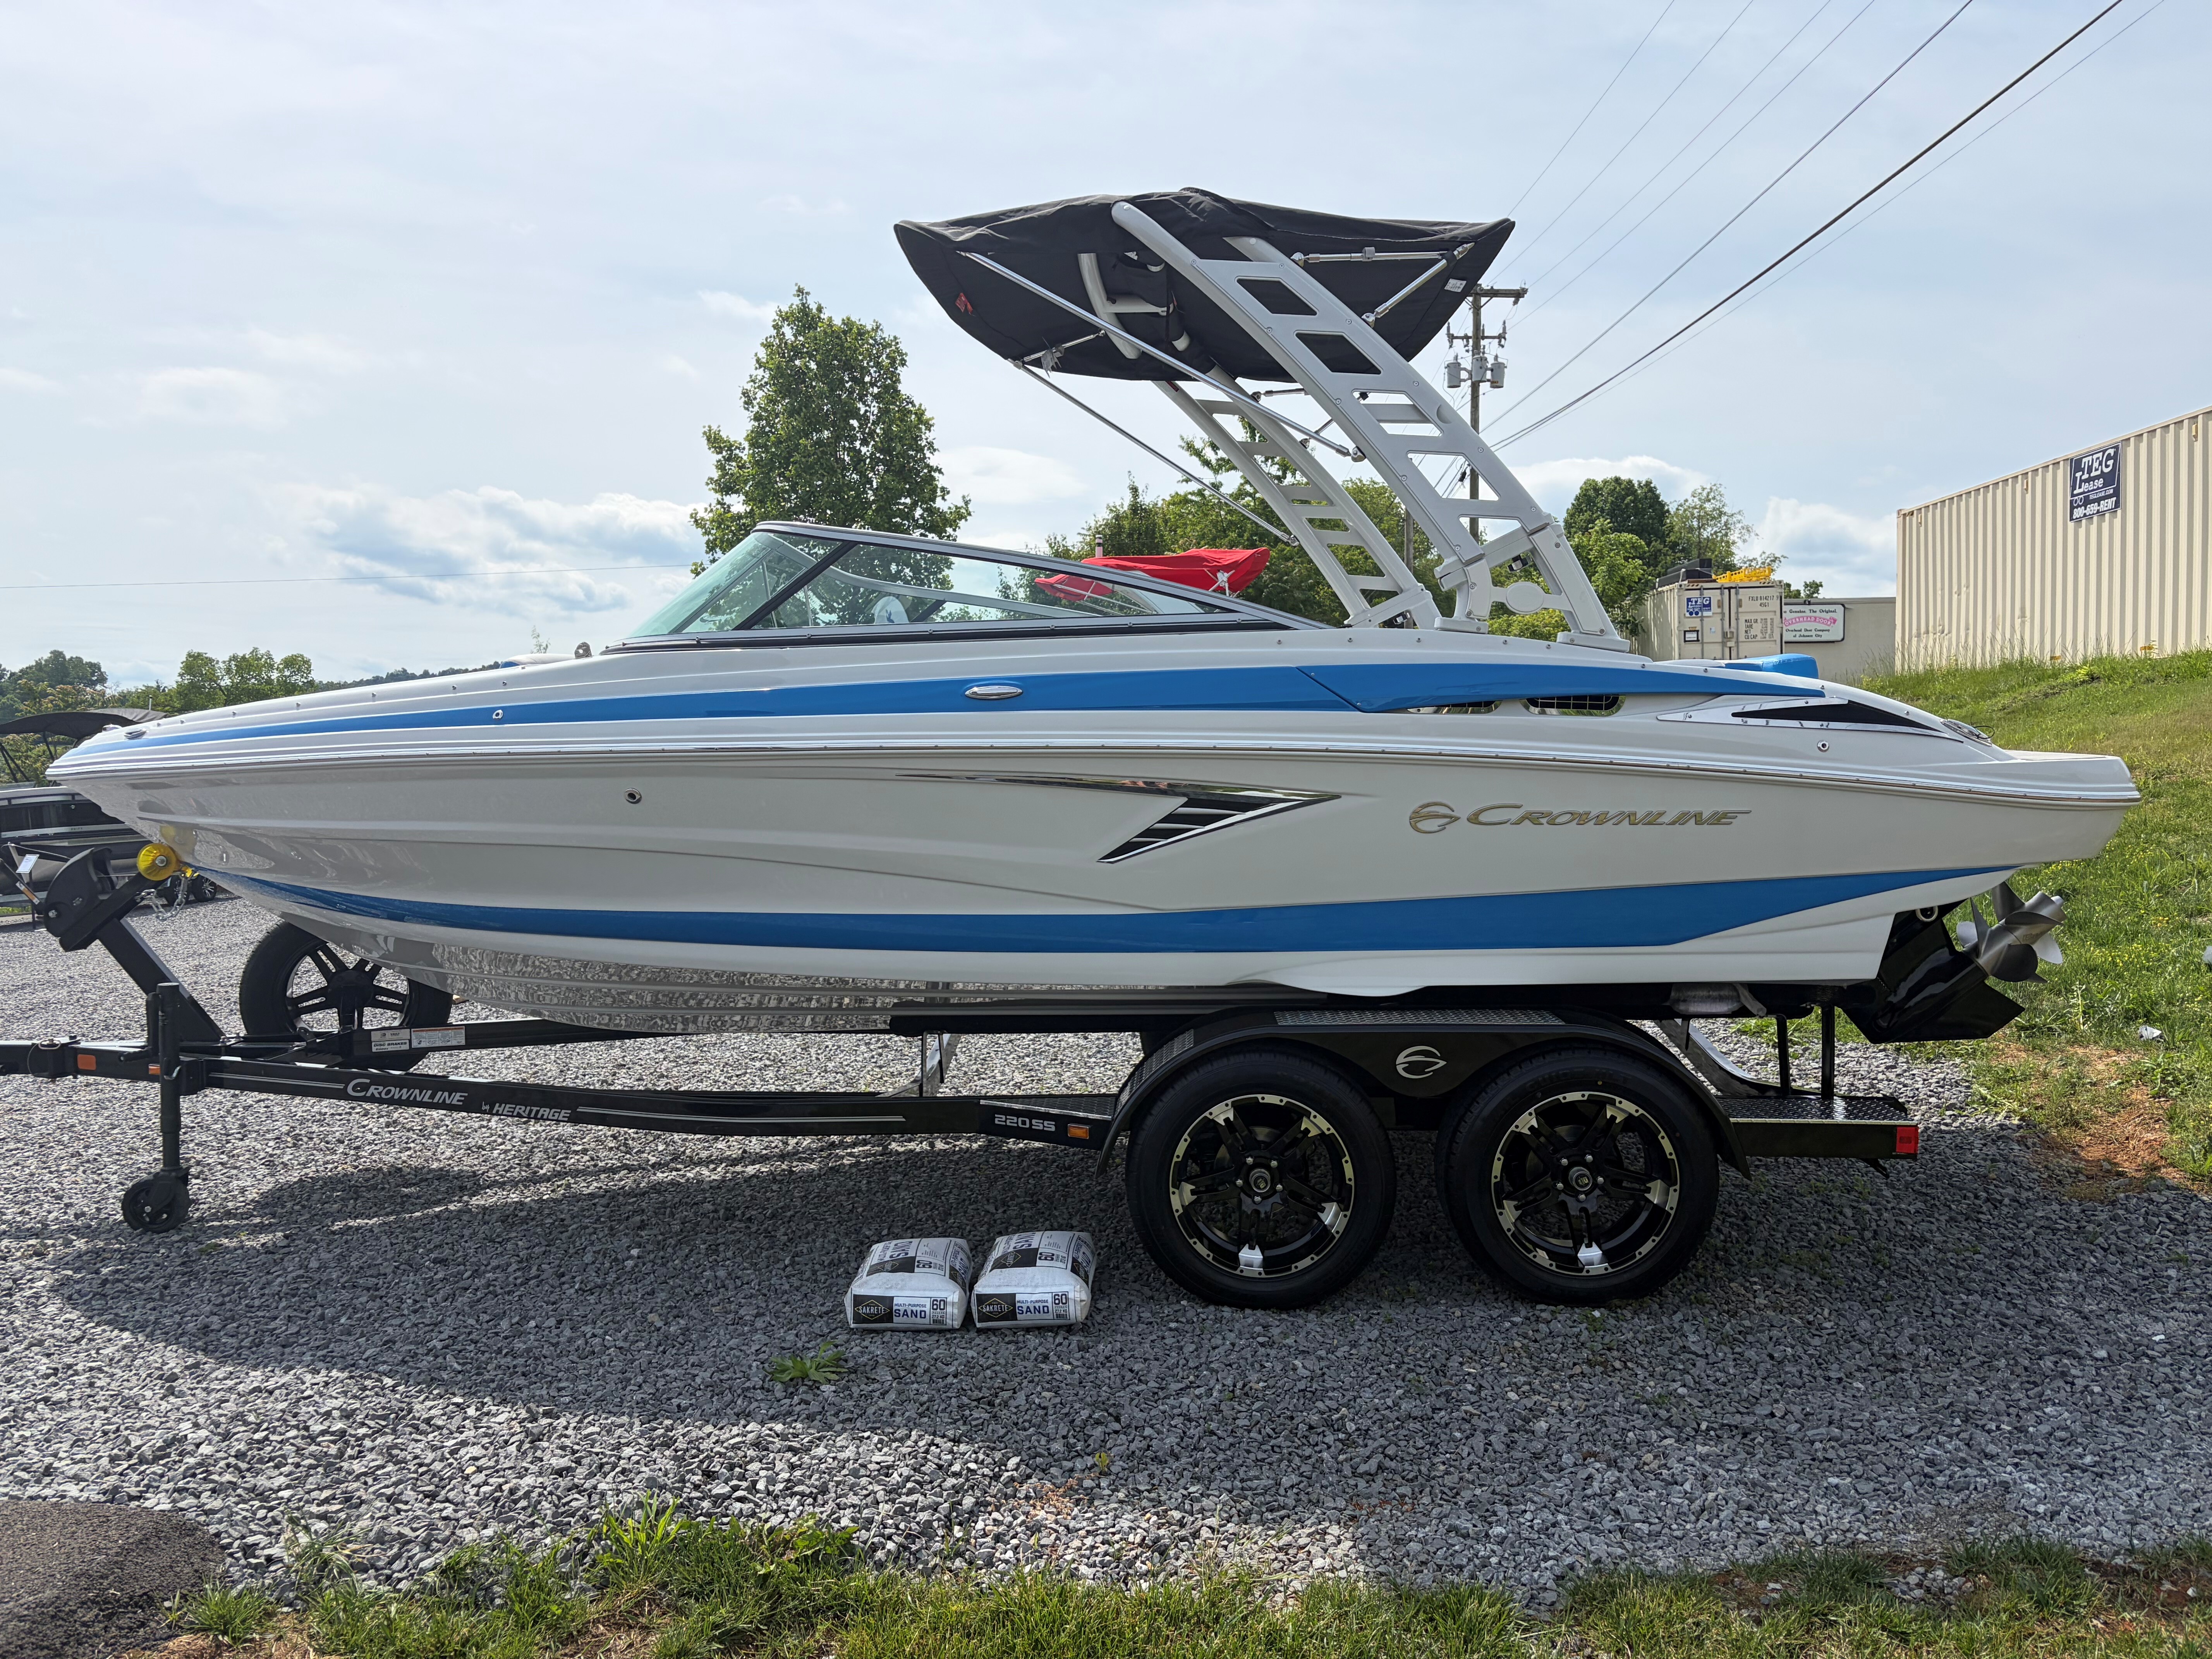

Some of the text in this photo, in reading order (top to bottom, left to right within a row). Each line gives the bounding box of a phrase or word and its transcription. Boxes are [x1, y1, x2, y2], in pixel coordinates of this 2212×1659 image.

[2081, 448, 2114, 479] TEG
[2073, 471, 2104, 495] Lease
[2073, 497, 2117, 519] 800-659-RENT
[1785, 617, 1815, 625] OVERHEAD
[1466, 803, 1752, 826] CROWNLINE
[347, 1078, 468, 1105] CROWNLINE
[482, 1101, 572, 1121] by HERITAGE
[1038, 1251, 1055, 1261] 60
[916, 1259, 933, 1269] 60
[931, 1298, 946, 1311] 60
[1053, 1293, 1067, 1305] 60
[858, 1306, 885, 1314] SAKRETE
[894, 1308, 927, 1319] SAND
[982, 1304, 1008, 1312] SAKRETE
[1017, 1305, 1049, 1315] SAND
